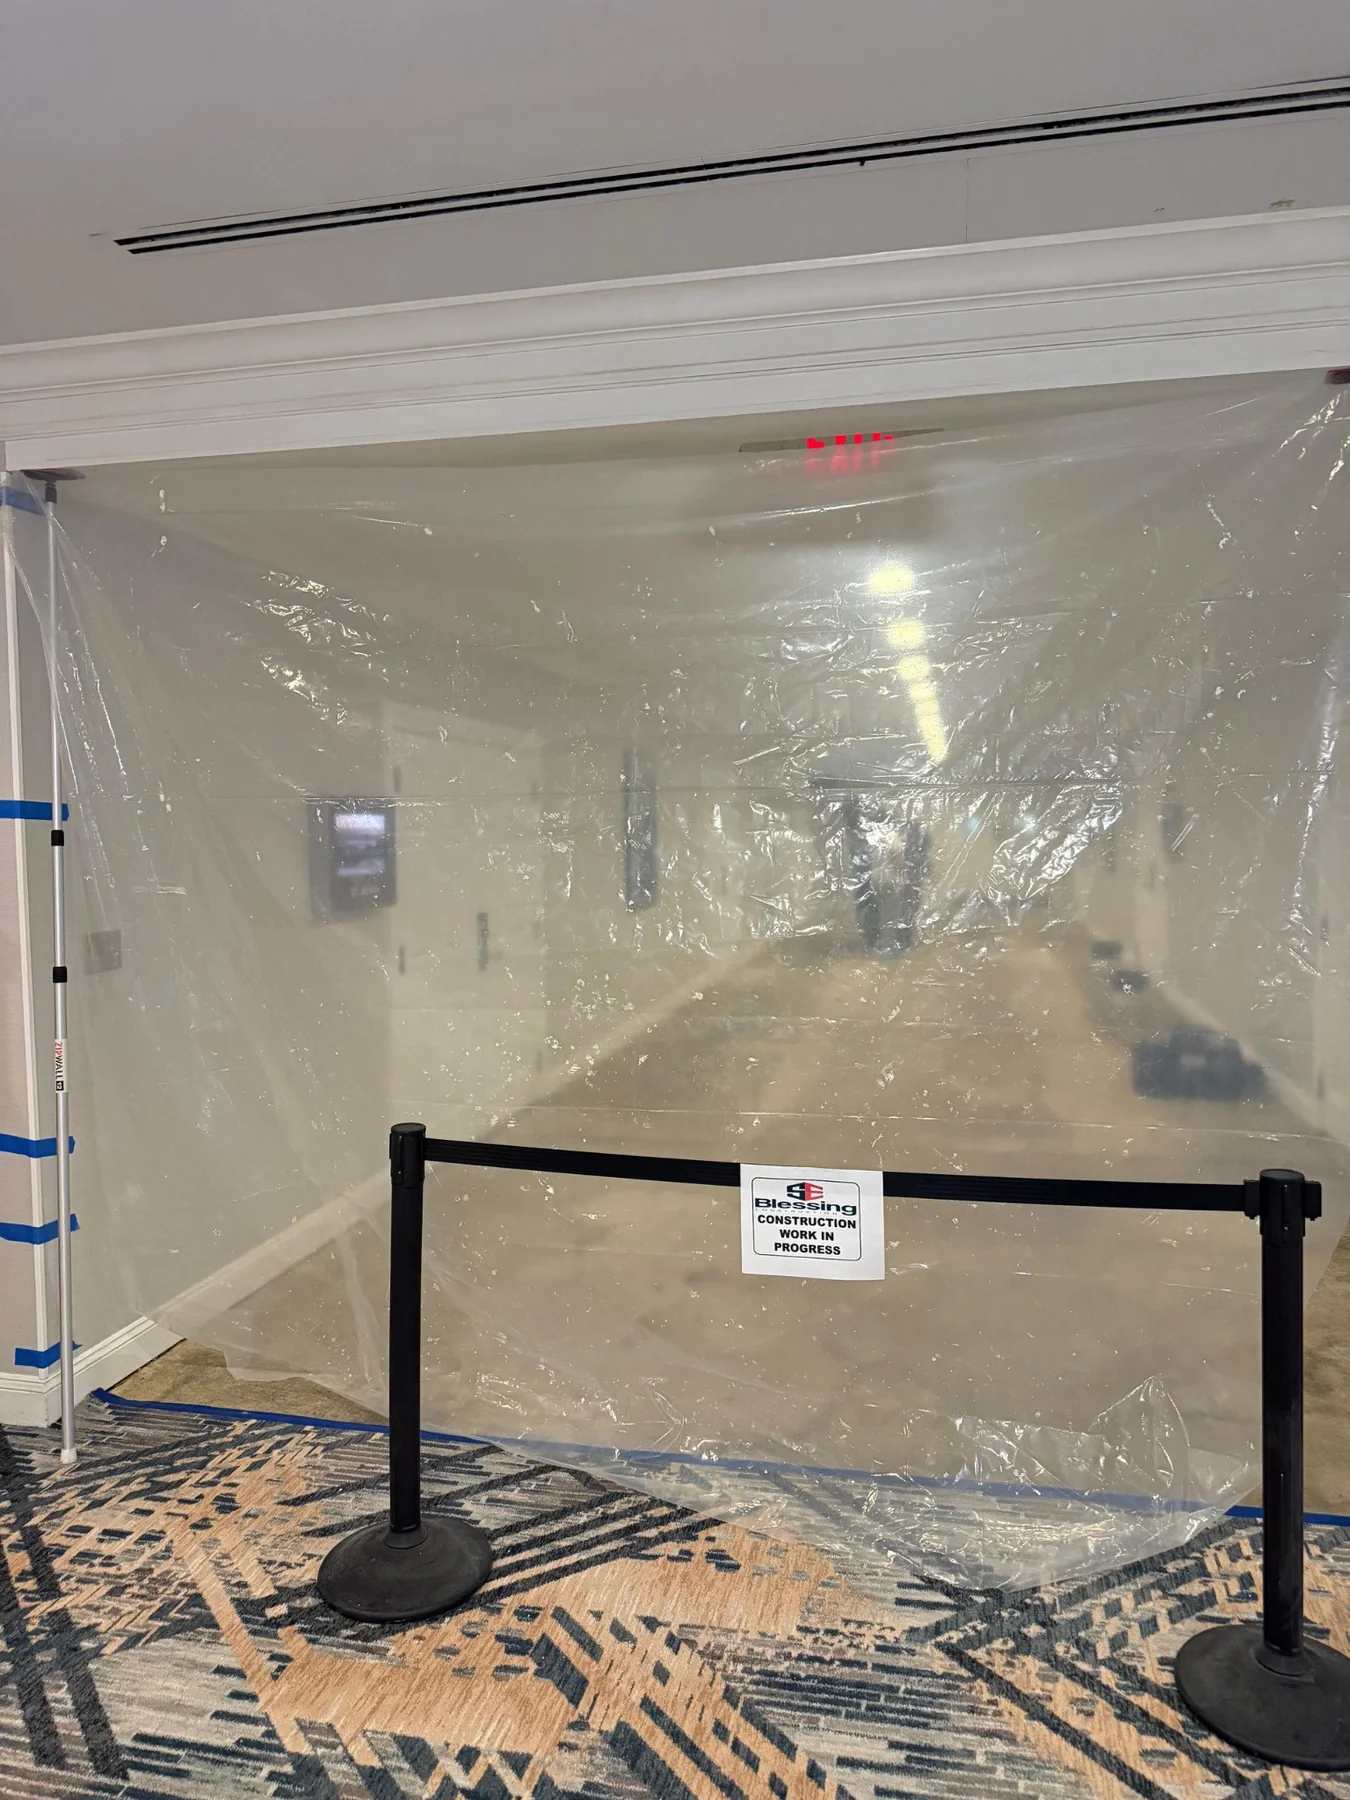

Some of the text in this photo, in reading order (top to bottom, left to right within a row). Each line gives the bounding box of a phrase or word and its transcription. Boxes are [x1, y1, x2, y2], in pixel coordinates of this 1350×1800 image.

[755, 1198, 857, 1216] Blessing
[757, 1215, 856, 1229] CONSTRUCTION
[779, 1229, 834, 1241] WORK IN
[774, 1242, 841, 1255] PROGRESS
